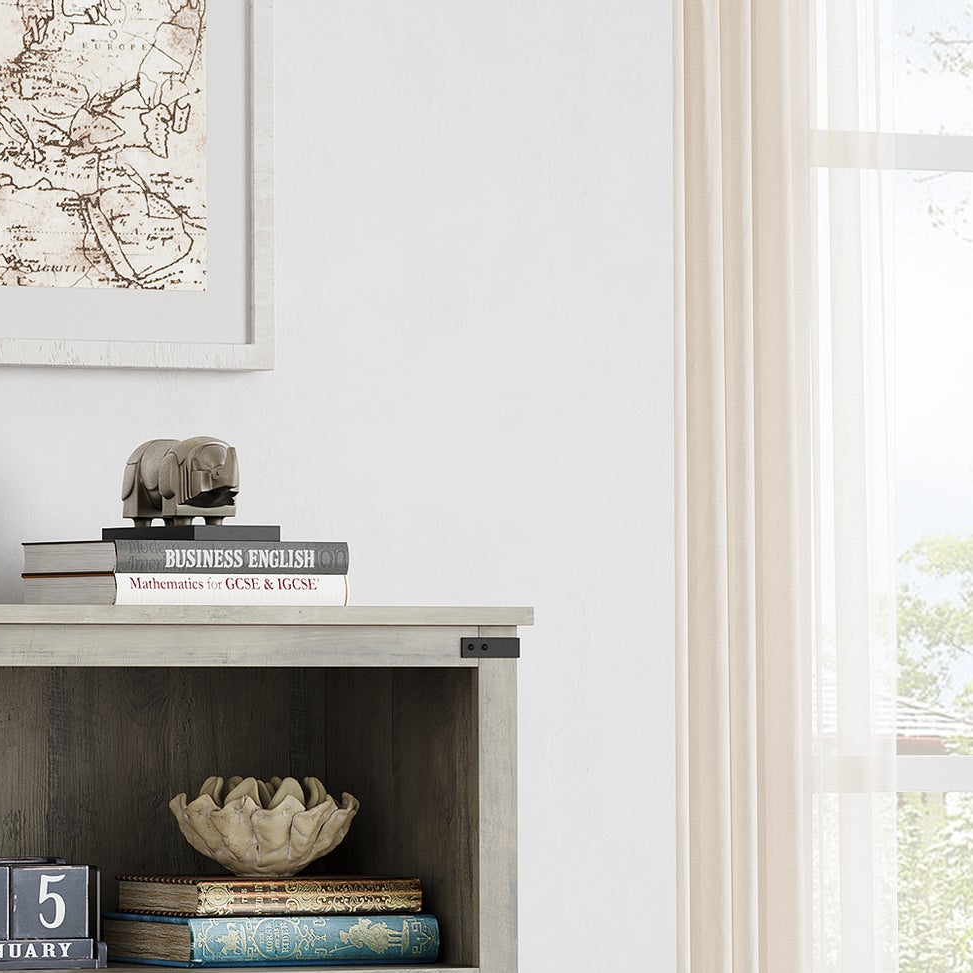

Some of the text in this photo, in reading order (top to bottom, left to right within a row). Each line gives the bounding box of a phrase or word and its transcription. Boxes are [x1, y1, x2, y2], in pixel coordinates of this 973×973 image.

[82, 42, 147, 50] EUROPE
[165, 549, 314, 569] BUSINESS ENGLISH
[130, 577, 316, 591] Mathematics for GCSE & IGCSE
[39, 874, 66, 929] 5
[265, 923, 273, 952] HORSE
[280, 922, 289, 953] RIDER
